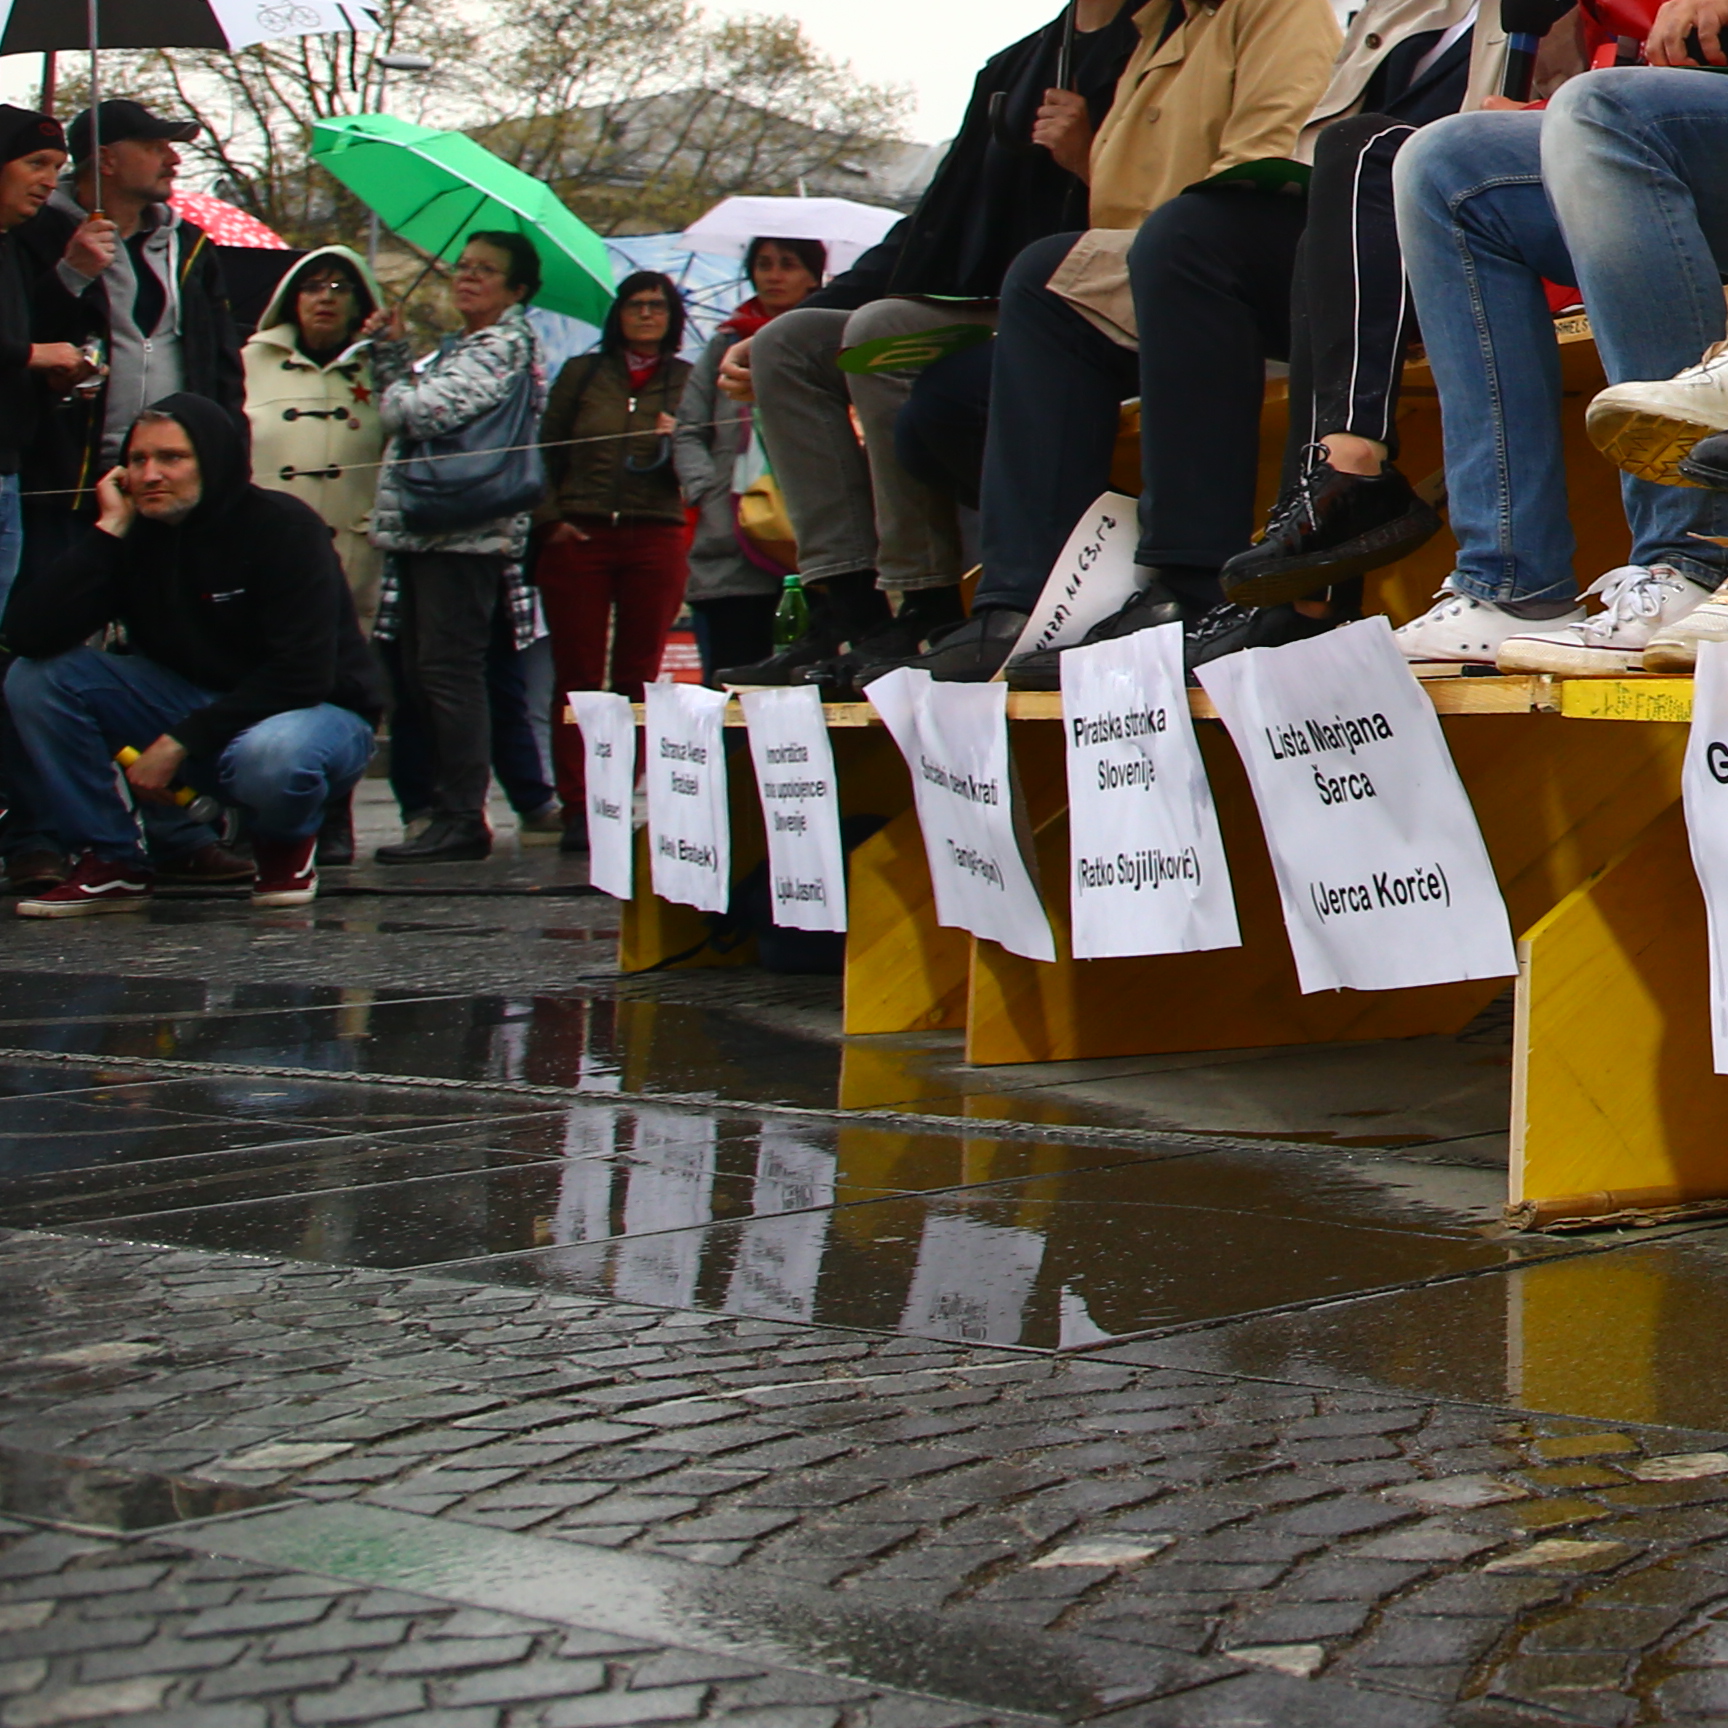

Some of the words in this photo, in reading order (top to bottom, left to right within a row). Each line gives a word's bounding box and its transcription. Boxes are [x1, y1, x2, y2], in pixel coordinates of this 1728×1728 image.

[1073, 711, 1123, 748] Piratska
[1265, 723, 1312, 760] Lista
[1305, 713, 1393, 755] Marjana
[1098, 752, 1155, 791] Slovenije
[1311, 764, 1377, 805] Šarca
[1078, 857, 1115, 897] (Ratko
[1310, 882, 1373, 924] (Jerca
[1372, 863, 1450, 908] Korče)
